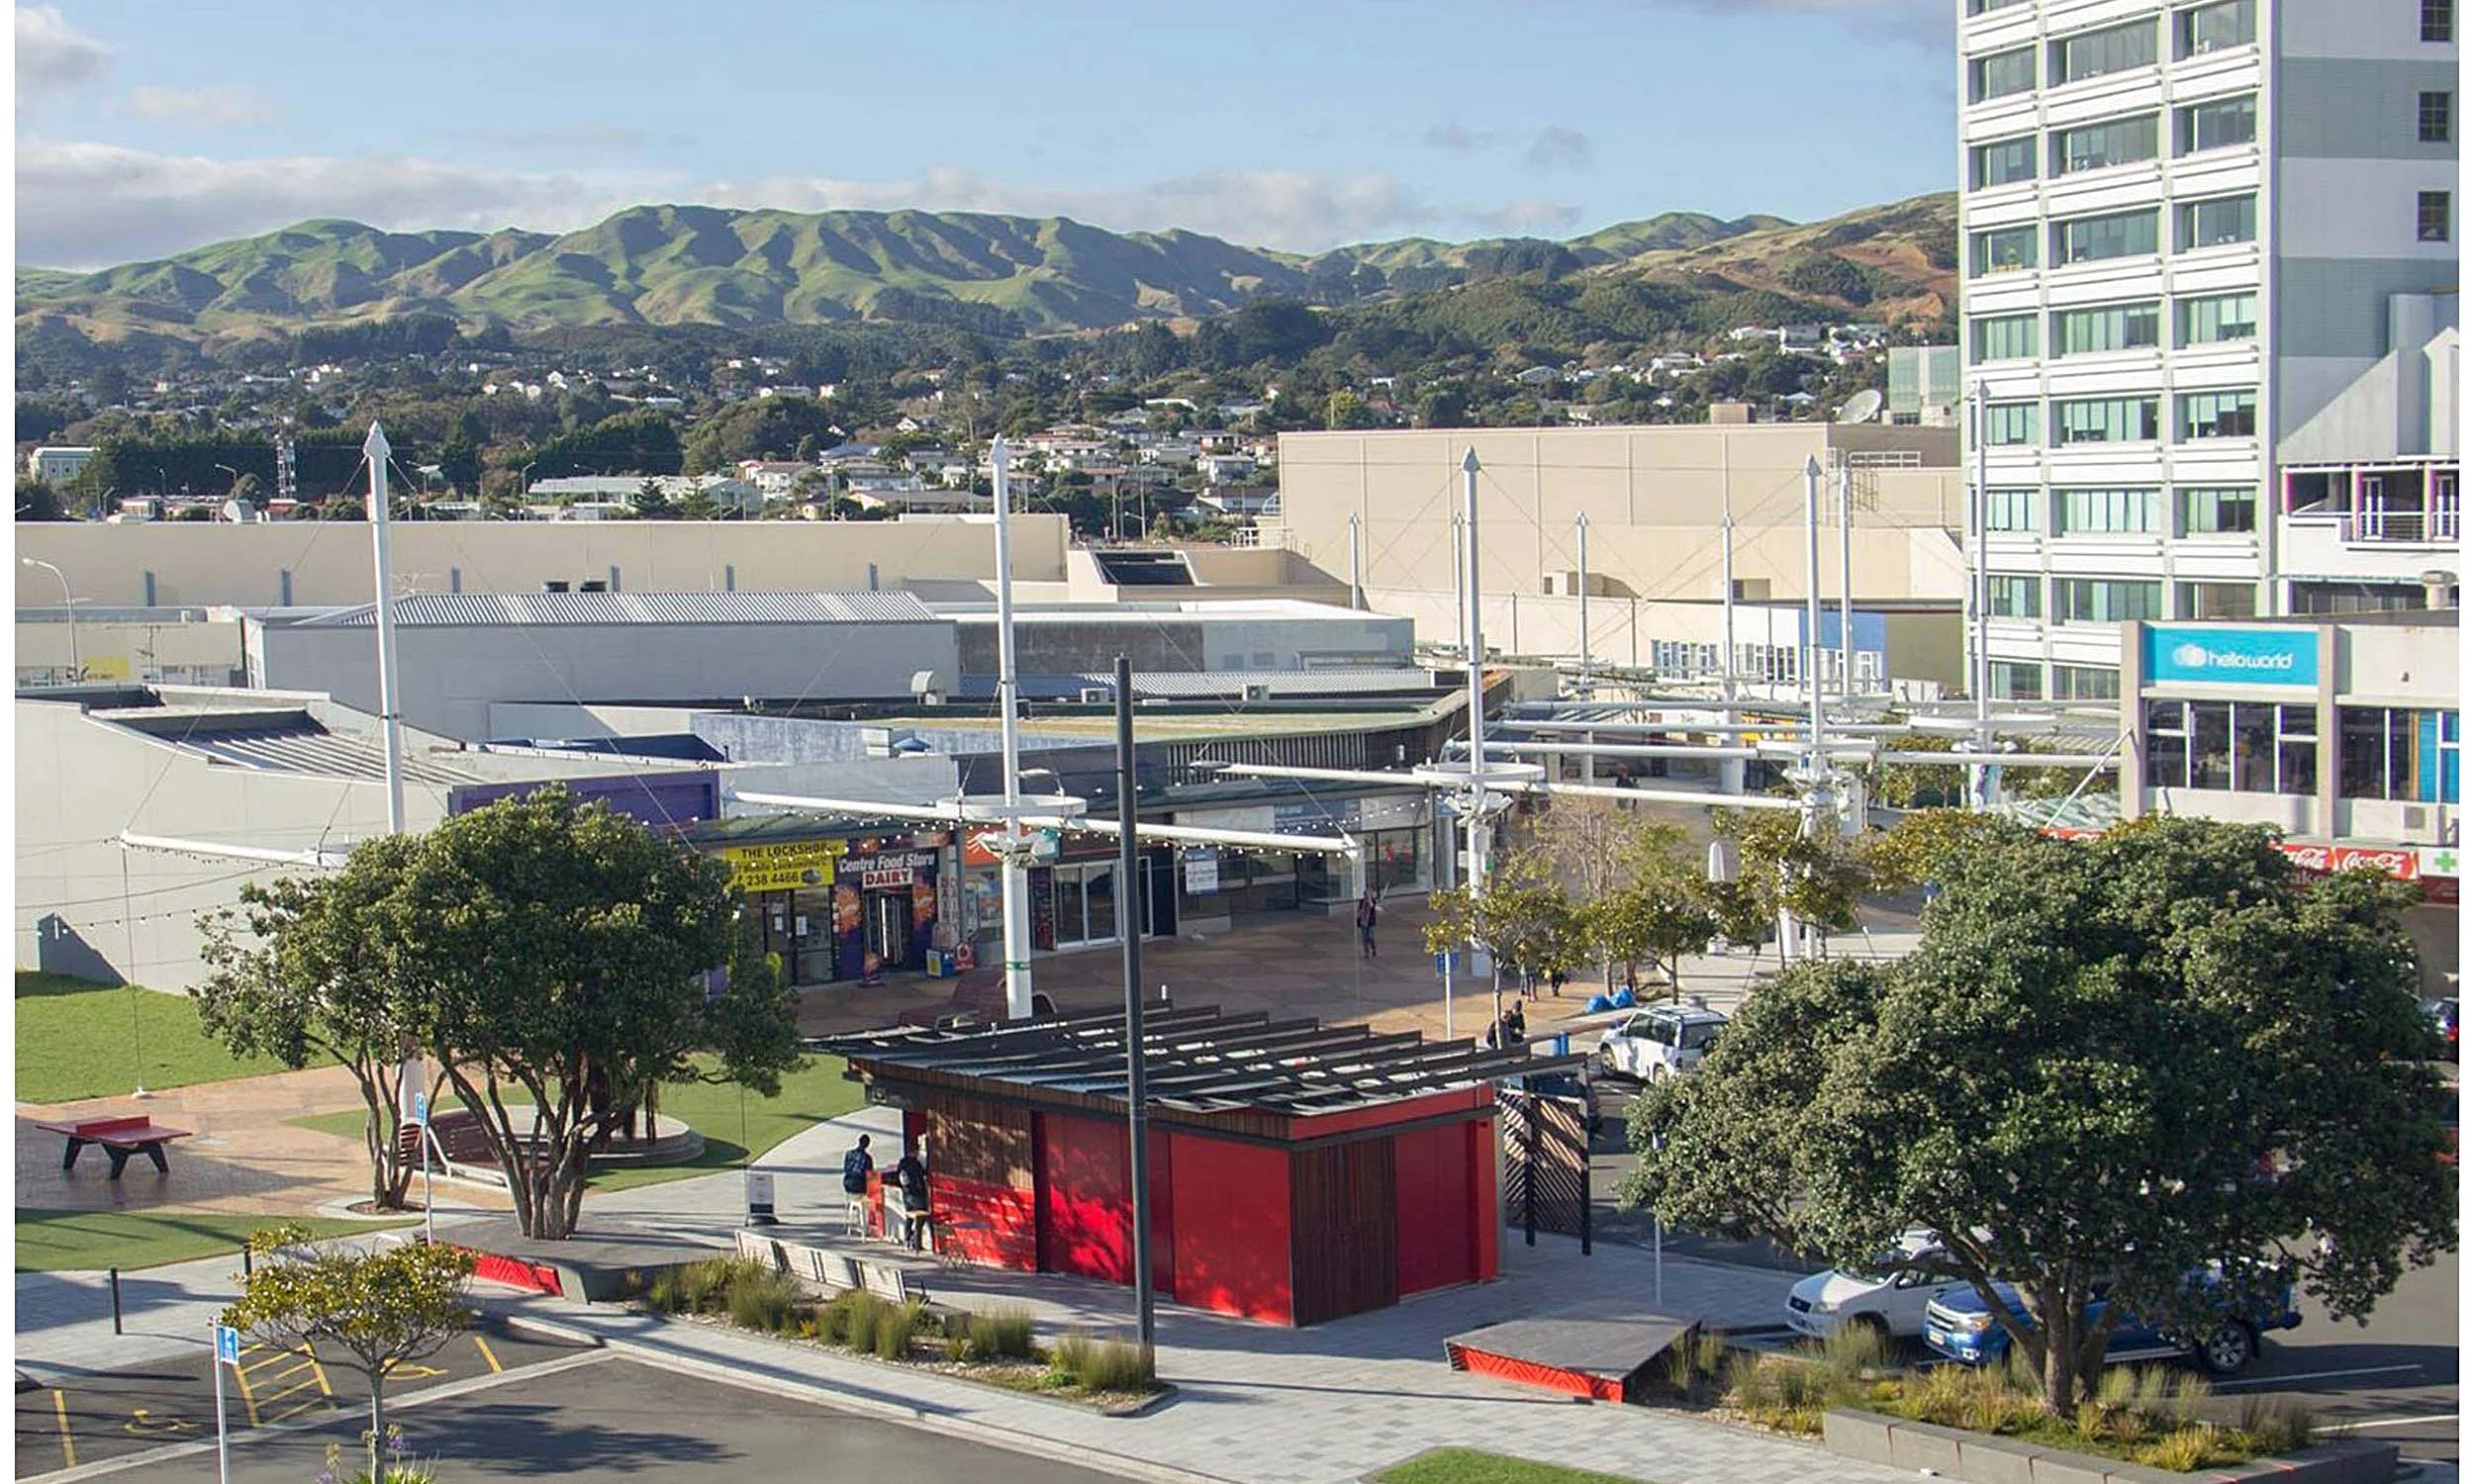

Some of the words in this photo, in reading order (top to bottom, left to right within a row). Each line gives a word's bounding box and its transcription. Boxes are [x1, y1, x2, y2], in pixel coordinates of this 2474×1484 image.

[2208, 651, 2294, 669] helloworld
[741, 848, 762, 859] THE
[838, 858, 876, 873] Centre
[877, 854, 904, 869] Food
[905, 851, 935, 867] Store
[746, 874, 768, 885] 238
[865, 871, 911, 885] DAIRY
